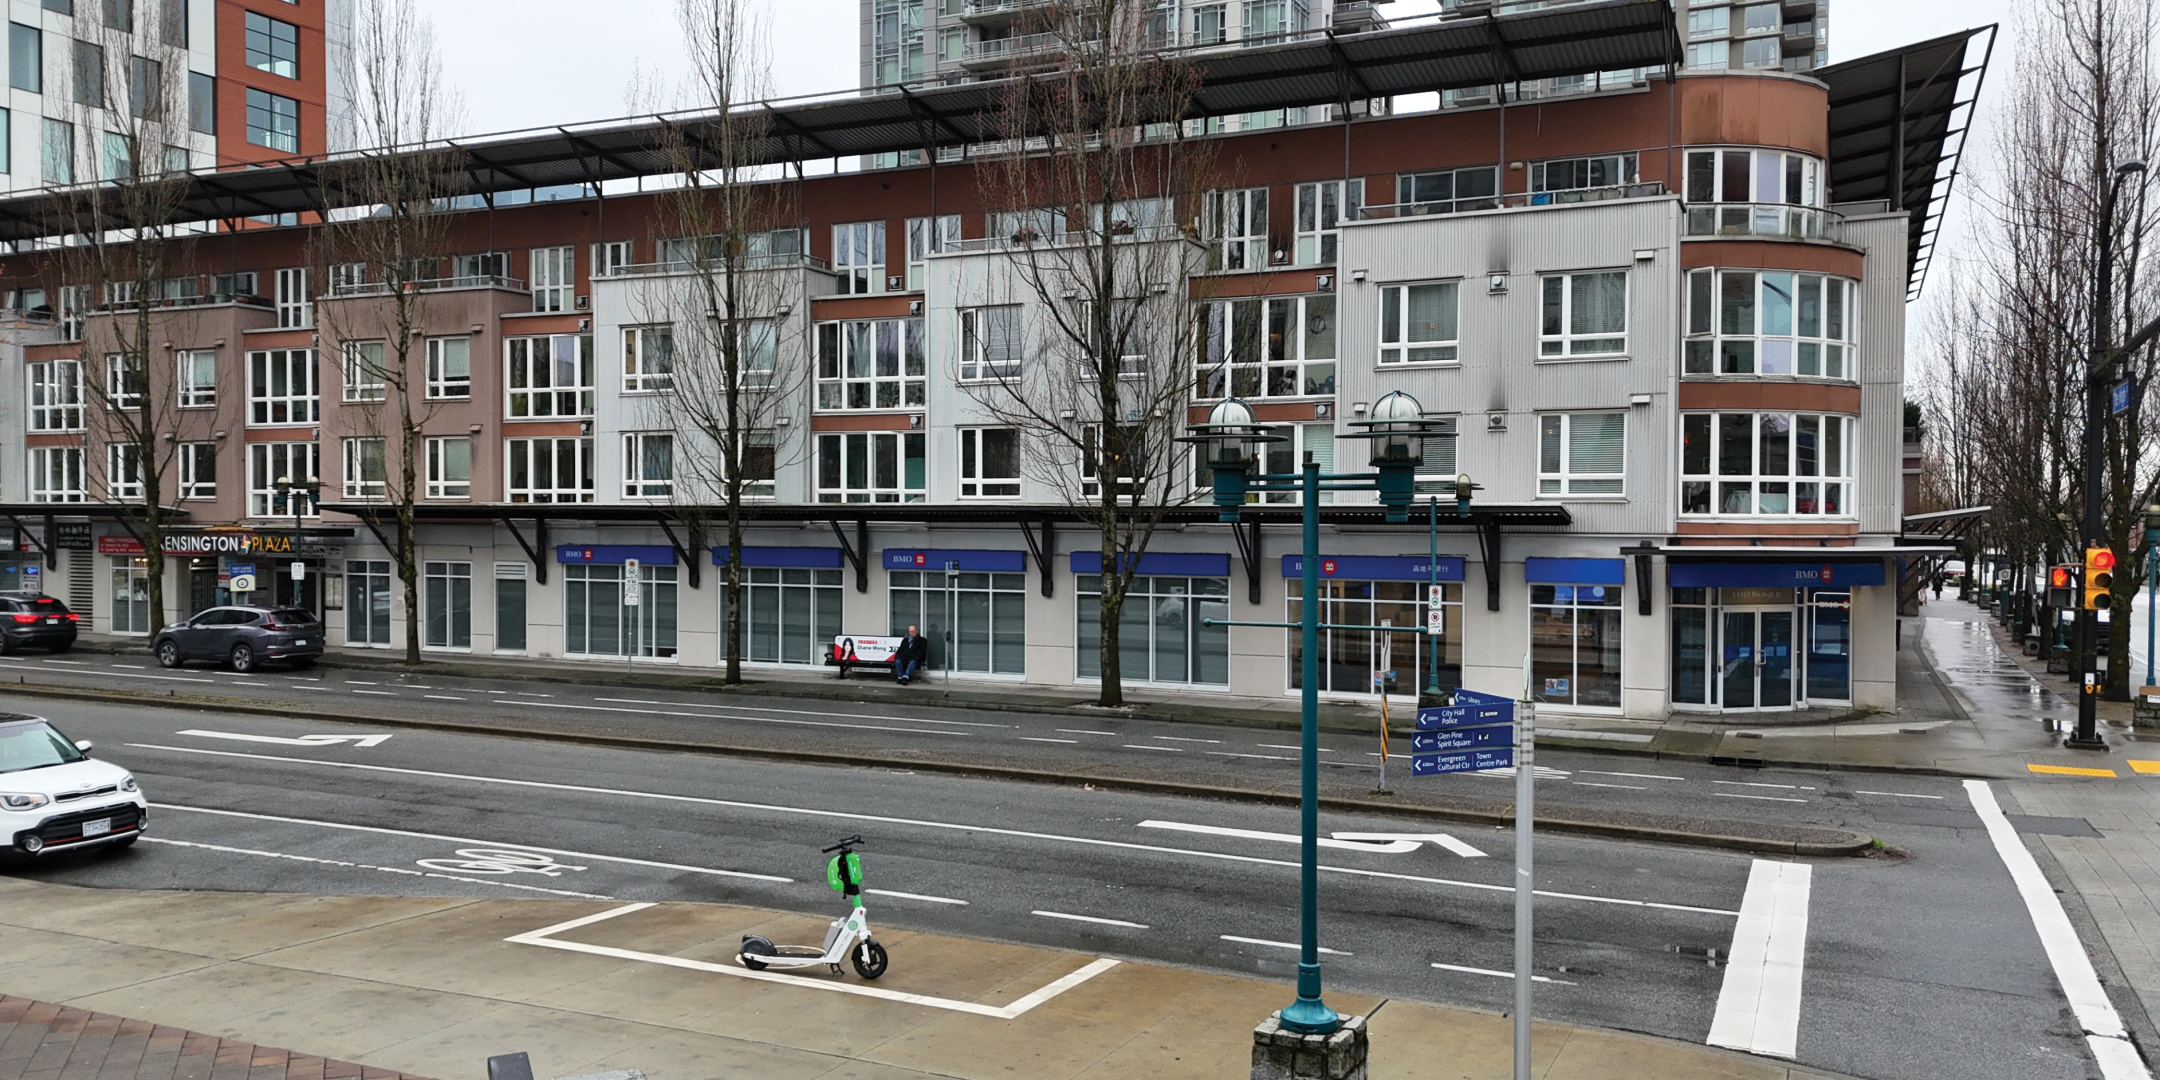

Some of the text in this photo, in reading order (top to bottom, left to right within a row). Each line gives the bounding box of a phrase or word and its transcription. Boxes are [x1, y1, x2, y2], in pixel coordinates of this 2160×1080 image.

[252, 536, 291, 552] PLAZA
[1795, 570, 1818, 579] BMO
[1442, 710, 1453, 718] City
[1437, 740, 1471, 749] Spirit Square
[1438, 755, 1466, 764] Evergreen
